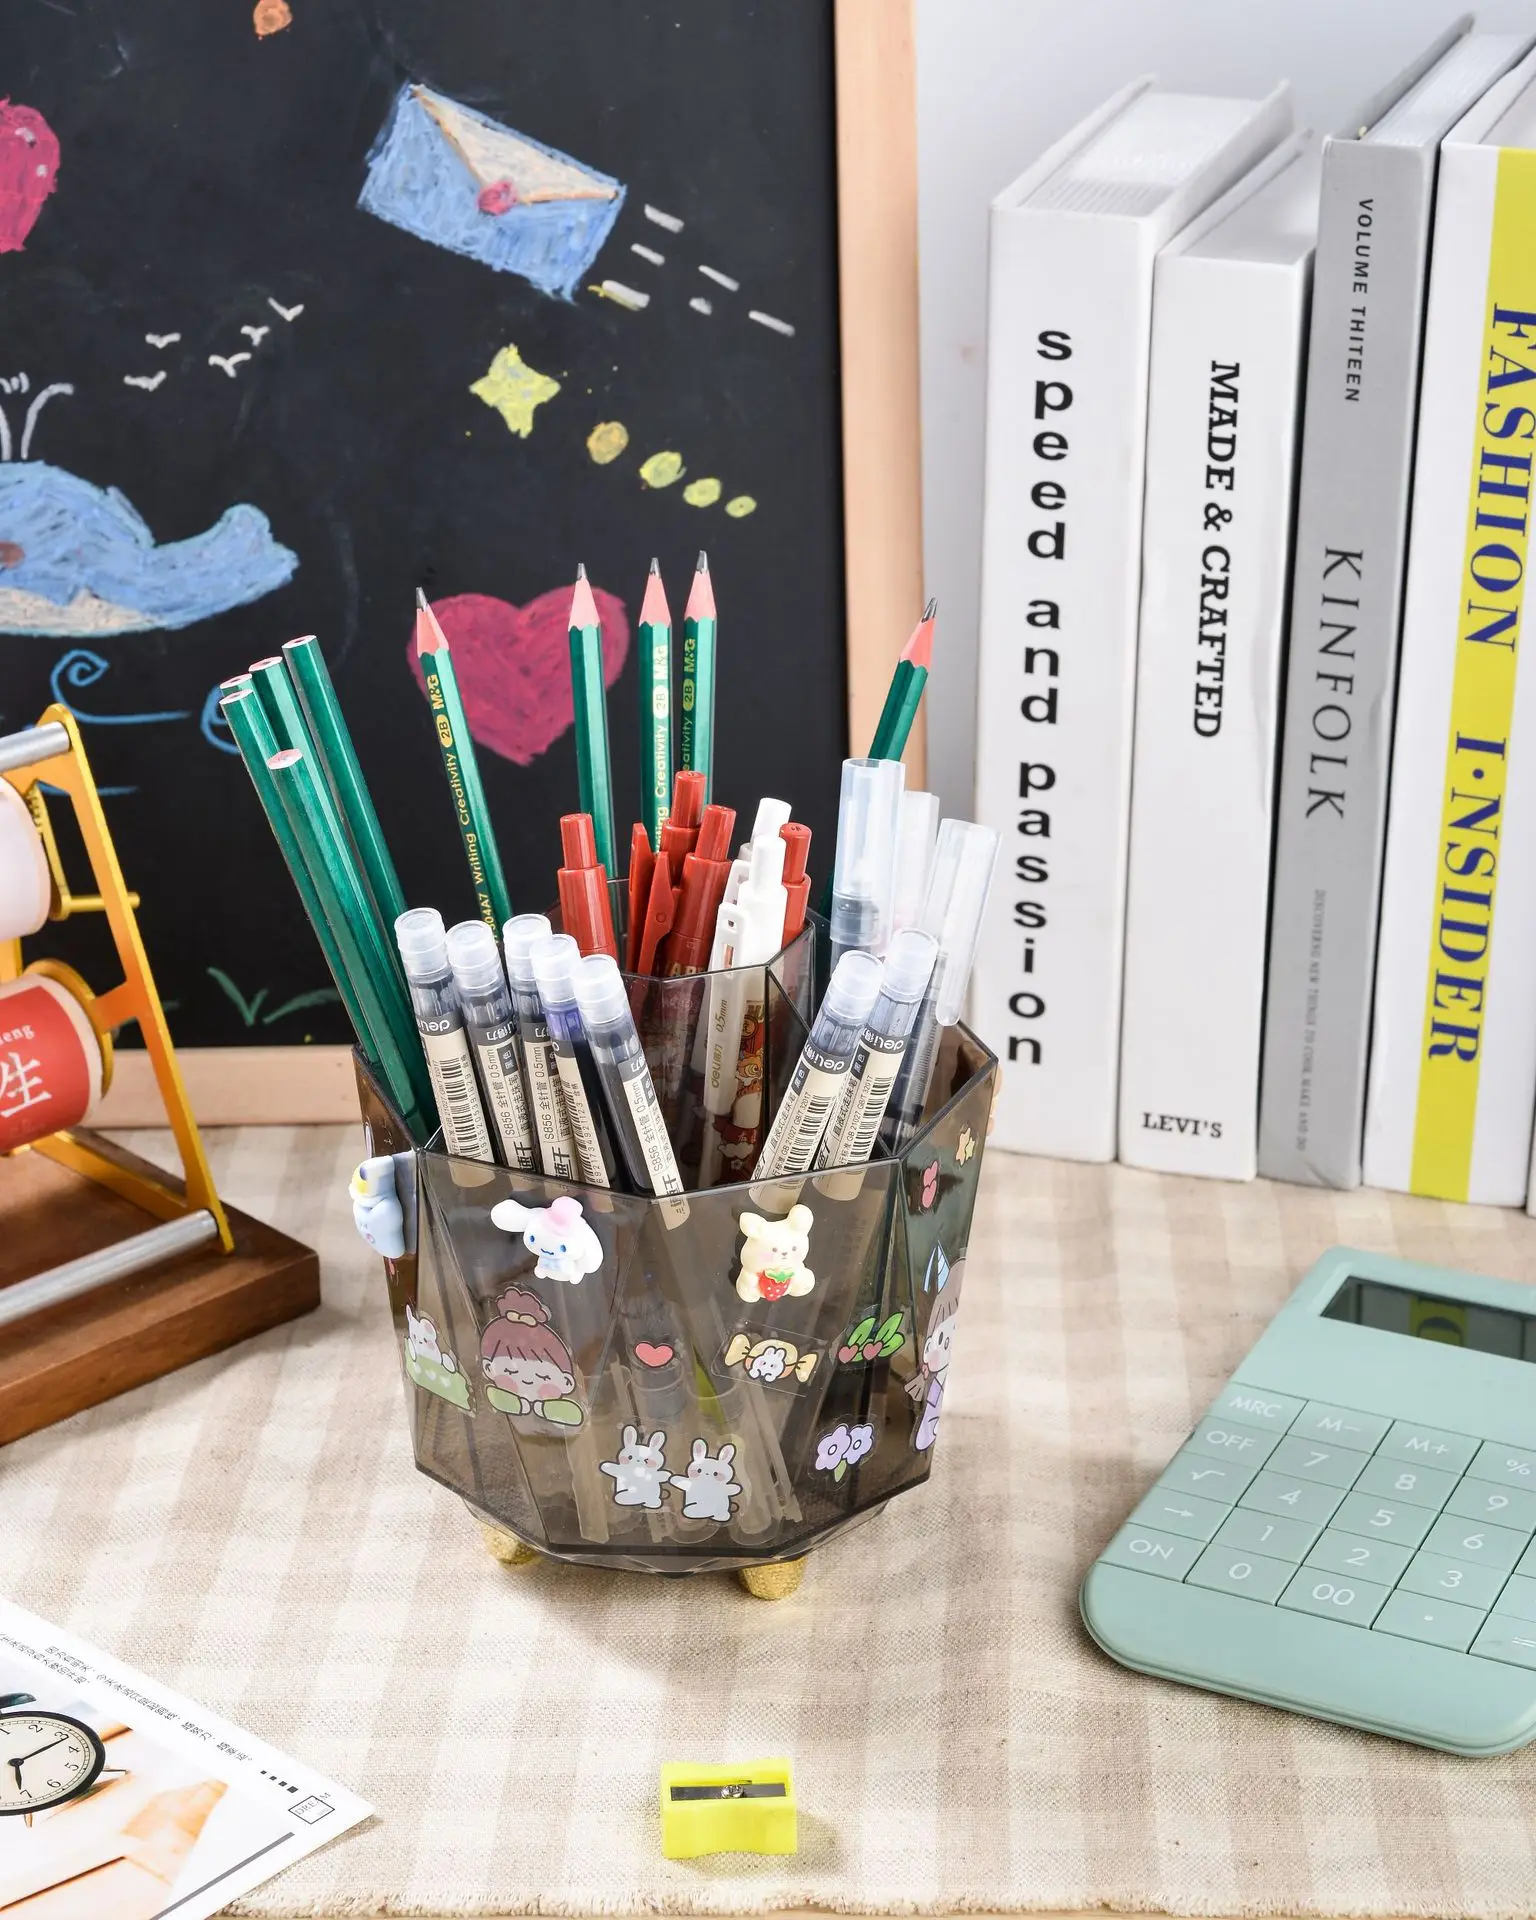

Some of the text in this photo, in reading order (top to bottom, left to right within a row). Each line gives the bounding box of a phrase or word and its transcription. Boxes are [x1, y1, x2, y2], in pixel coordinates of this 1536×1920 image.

[1345, 198, 1374, 402] VOLUME THITEEN
[1464, 303, 1536, 653] FASHION
[1193, 360, 1240, 738] MADE & CRAFTED
[653, 644, 669, 680] M&G
[684, 638, 696, 673] M&G
[427, 673, 445, 710] M&G
[1304, 546, 1365, 819] KINFOLK
[1007, 329, 1074, 1065] speed and passion
[681, 717, 693, 772] eativity
[654, 725, 669, 798] Creativity
[446, 752, 470, 826] Creativity
[466, 833, 483, 884] Writing
[716, 999, 728, 1033] 0.5mm
[487, 1048, 500, 1079] 0.5mm
[533, 1046, 545, 1078] 0.5mm
[863, 1075, 874, 1094] 32017
[535, 1081, 551, 1111] 全针管
[632, 1081, 646, 1113] 0.5mm
[800, 1091, 813, 1112] 32017
[502, 1111, 516, 1136] S856
[541, 1114, 555, 1140] S856
[849, 1110, 861, 1132] 21027
[1142, 1112, 1223, 1139] LEVI'S
[579, 1102, 604, 1184] 6921734921123
[785, 1126, 798, 1145] 21027
[846, 1129, 854, 1142] GB
[649, 1145, 664, 1172] S856
[781, 1142, 790, 1157] GB
[771, 1156, 784, 1178] 行标准
[1228, 1395, 1282, 1419] MRC
[1205, 1430, 1256, 1451] OFF
[1404, 1436, 1451, 1456] M+
[1302, 1452, 1330, 1468] 7
[1506, 1458, 1532, 1476] %
[1395, 1473, 1418, 1491] 8
[1278, 1489, 1303, 1506] 4
[1487, 1495, 1509, 1512] 9
[1369, 1510, 1394, 1528] 5
[1261, 1525, 1275, 1542] 1
[1462, 1532, 1485, 1550] 6
[1128, 1538, 1175, 1561] ON
[1345, 1548, 1372, 1568] 2
[1228, 1563, 1253, 1581] 0
[1439, 1570, 1464, 1588] 3
[1312, 1583, 1356, 1606] 00
[28, 1724, 43, 1733] 2
[54, 1731, 70, 1740] 3
[68, 1745, 81, 1753] 4
[64, 1762, 79, 1772] 5
[19, 1789, 33, 1799] 7
[46, 1778, 62, 1788] 6
